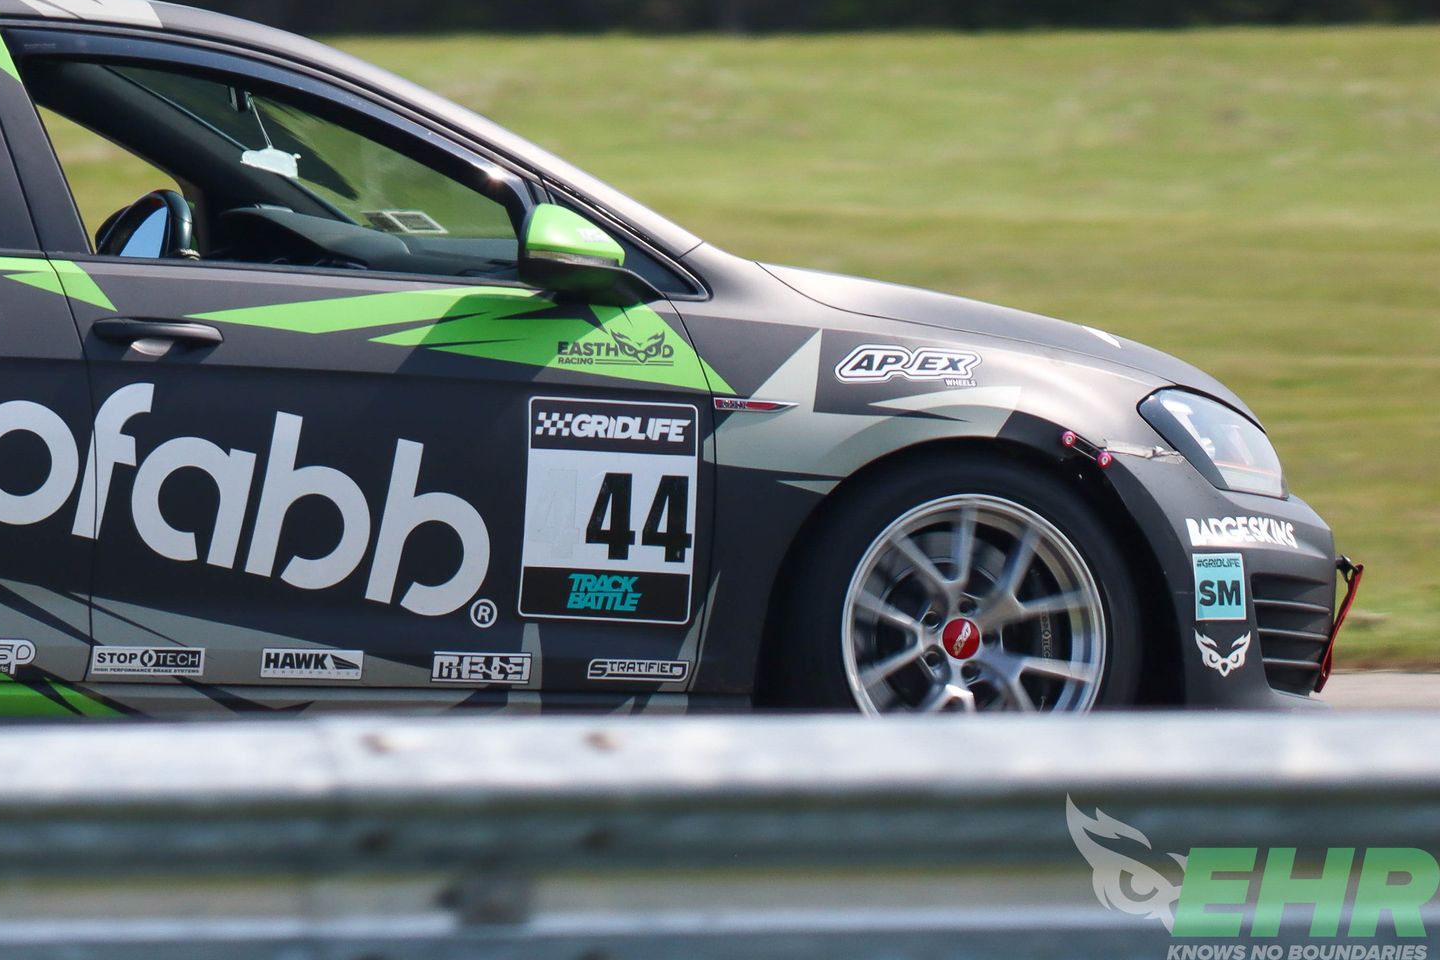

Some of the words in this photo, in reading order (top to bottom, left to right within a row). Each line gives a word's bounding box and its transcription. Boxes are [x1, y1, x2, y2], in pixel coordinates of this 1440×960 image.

[558, 357, 594, 365] RACING
[945, 377, 977, 387] WHEELS
[569, 413, 692, 443] GRIDLIFE
[585, 472, 693, 563] 44
[1185, 516, 1298, 549] BADGESKINS
[567, 572, 639, 593] TRACK
[566, 591, 643, 612] BATTLE
[1198, 580, 1242, 607] SM
[96, 652, 138, 665] STOP
[157, 653, 200, 667] TECH
[264, 652, 329, 670] HAWK
[588, 659, 689, 681] STRATIFIED
